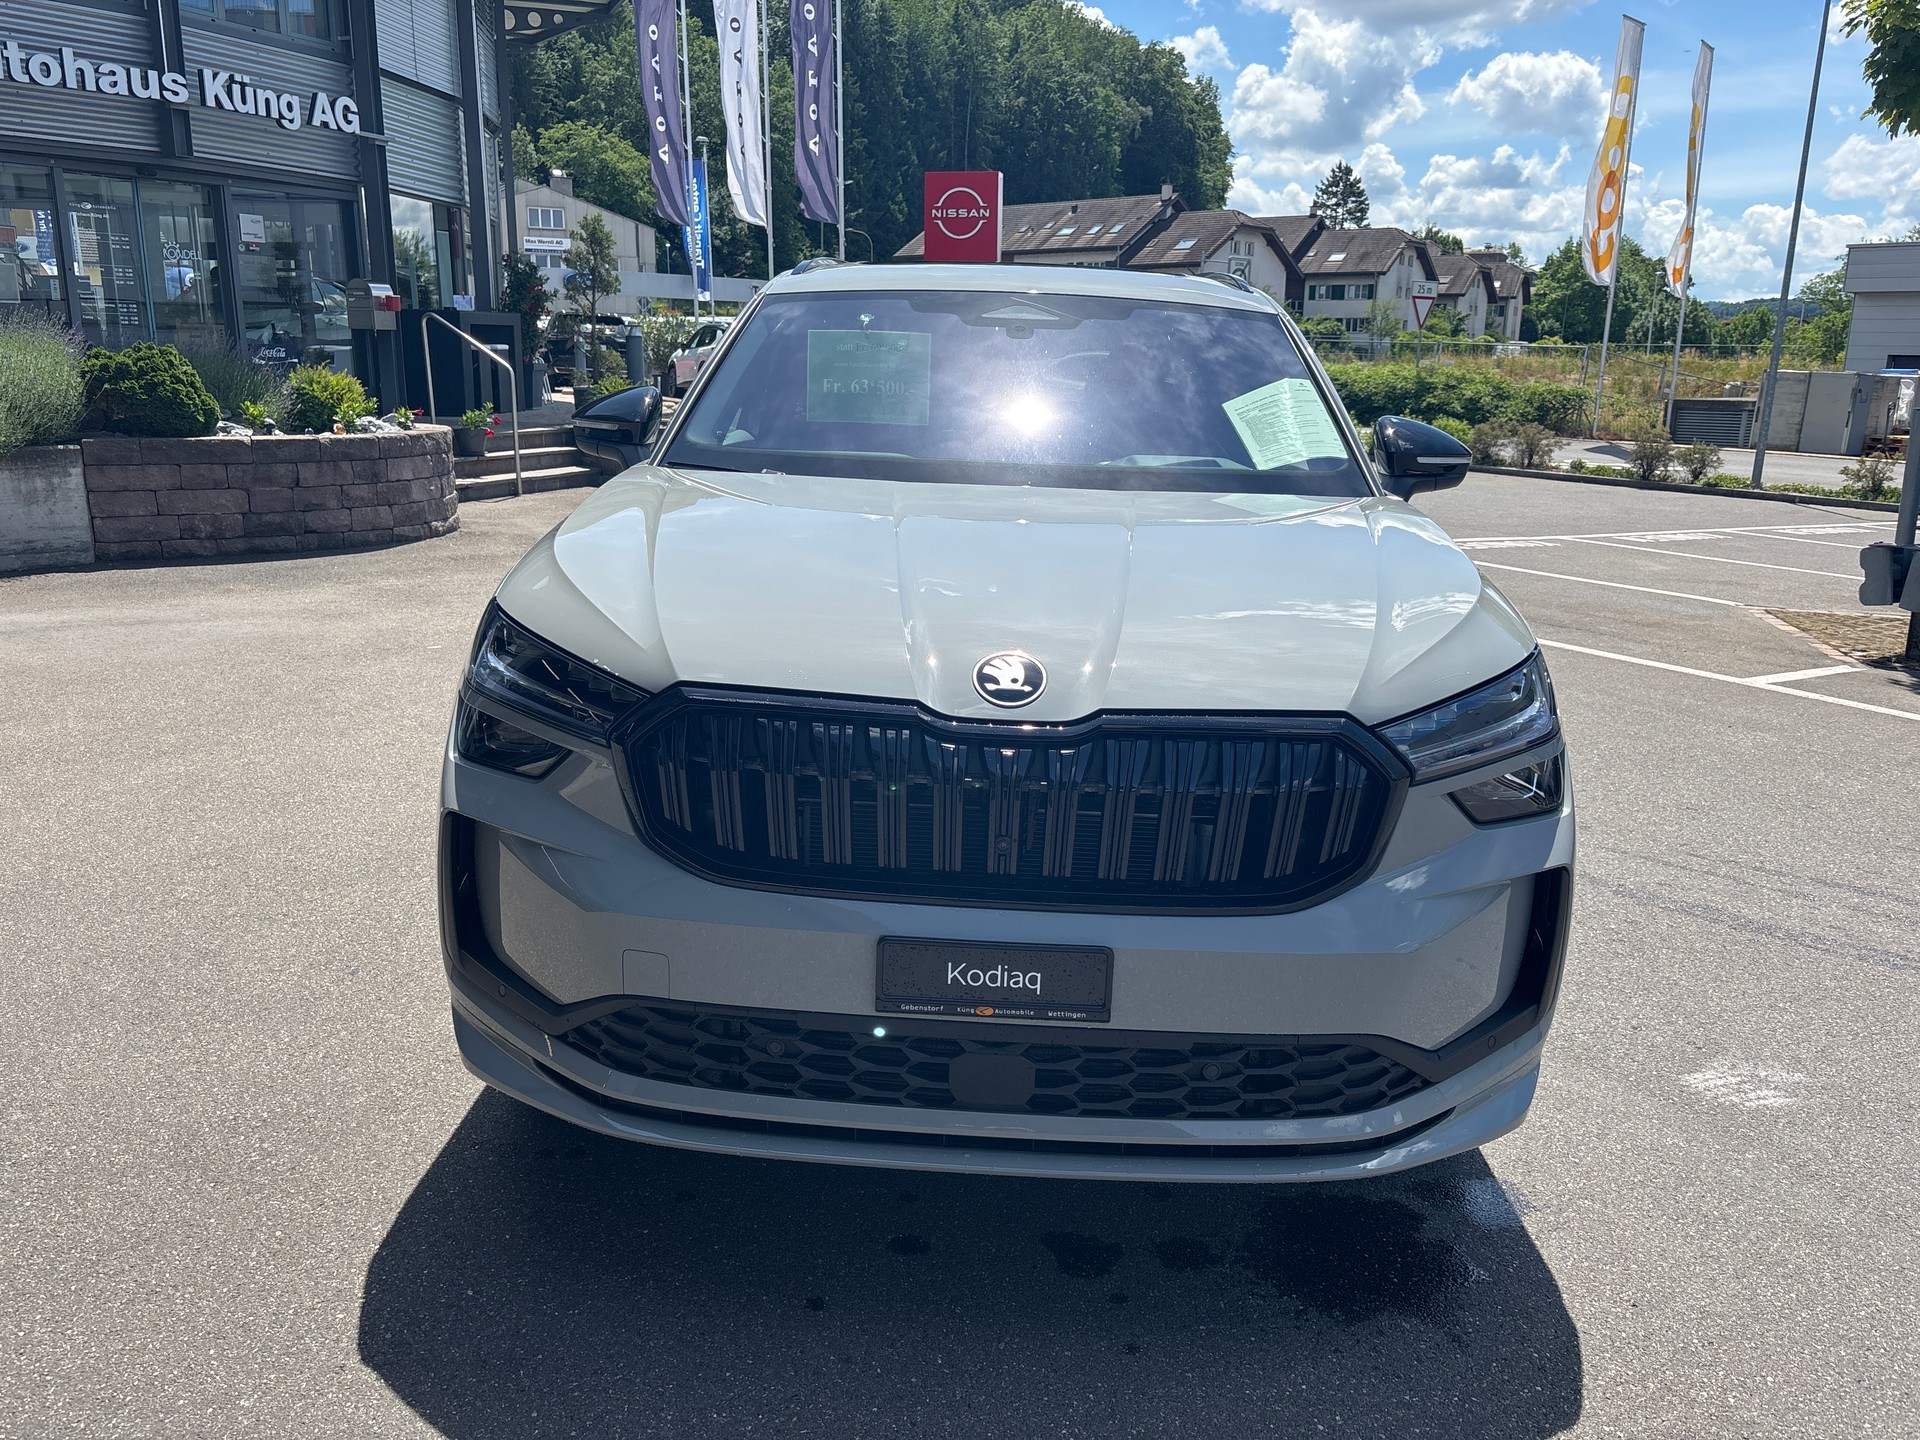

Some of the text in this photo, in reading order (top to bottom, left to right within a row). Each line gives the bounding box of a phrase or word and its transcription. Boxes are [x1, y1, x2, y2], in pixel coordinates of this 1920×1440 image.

[0, 41, 361, 135] tohaus Küng AG
[931, 208, 990, 218] NISSAN
[1417, 284, 1433, 295] 25 m
[823, 378, 845, 393] Fr.
[947, 962, 1042, 996] Kodiaq
[900, 1003, 1087, 1019] Gebenstorf Küng Automobile Wettingen
